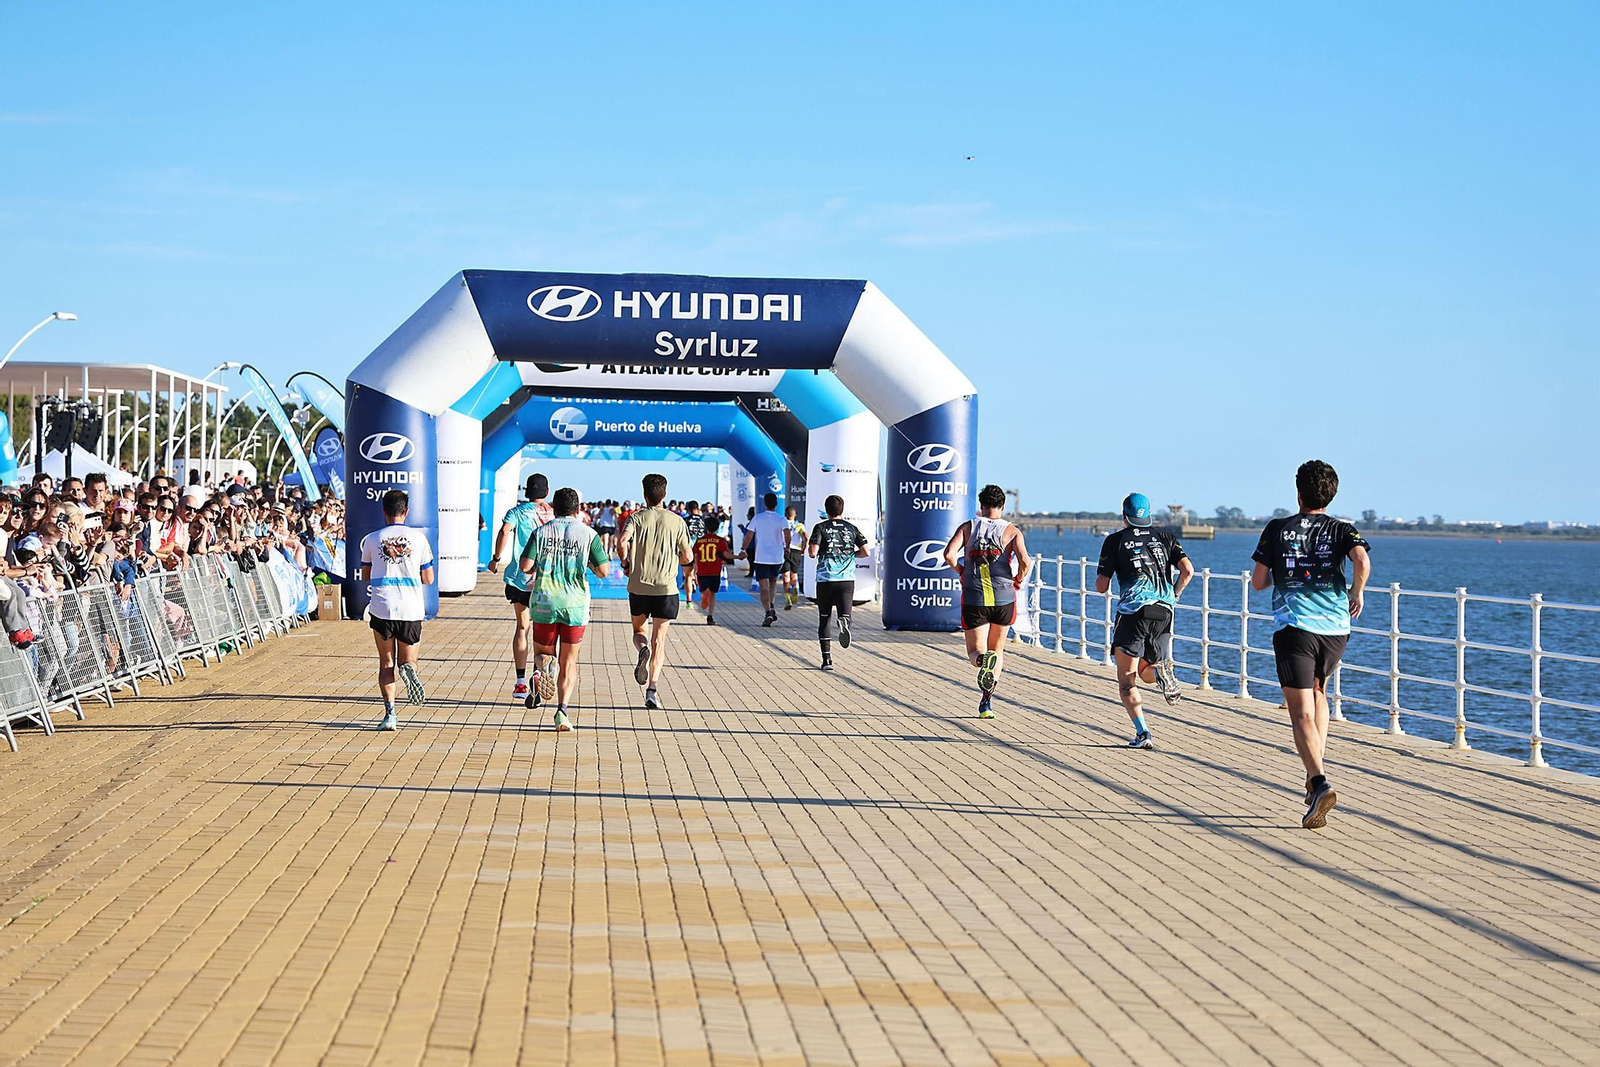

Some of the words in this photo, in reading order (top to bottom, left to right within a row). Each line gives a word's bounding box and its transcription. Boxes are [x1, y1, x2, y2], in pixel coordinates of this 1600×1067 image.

[613, 290, 802, 321] HYUNDAI
[654, 331, 758, 360] Syrluz
[595, 420, 636, 432] Puerto
[639, 420, 655, 432] de
[659, 421, 702, 433] Huelva
[353, 471, 423, 484] HYUNDAI
[899, 481, 968, 495] HYUNDAI
[912, 498, 954, 512] Syrluz
[698, 543, 717, 563] 10
[896, 578, 962, 591] HYUNDA
[910, 595, 952, 609] Syrluz
